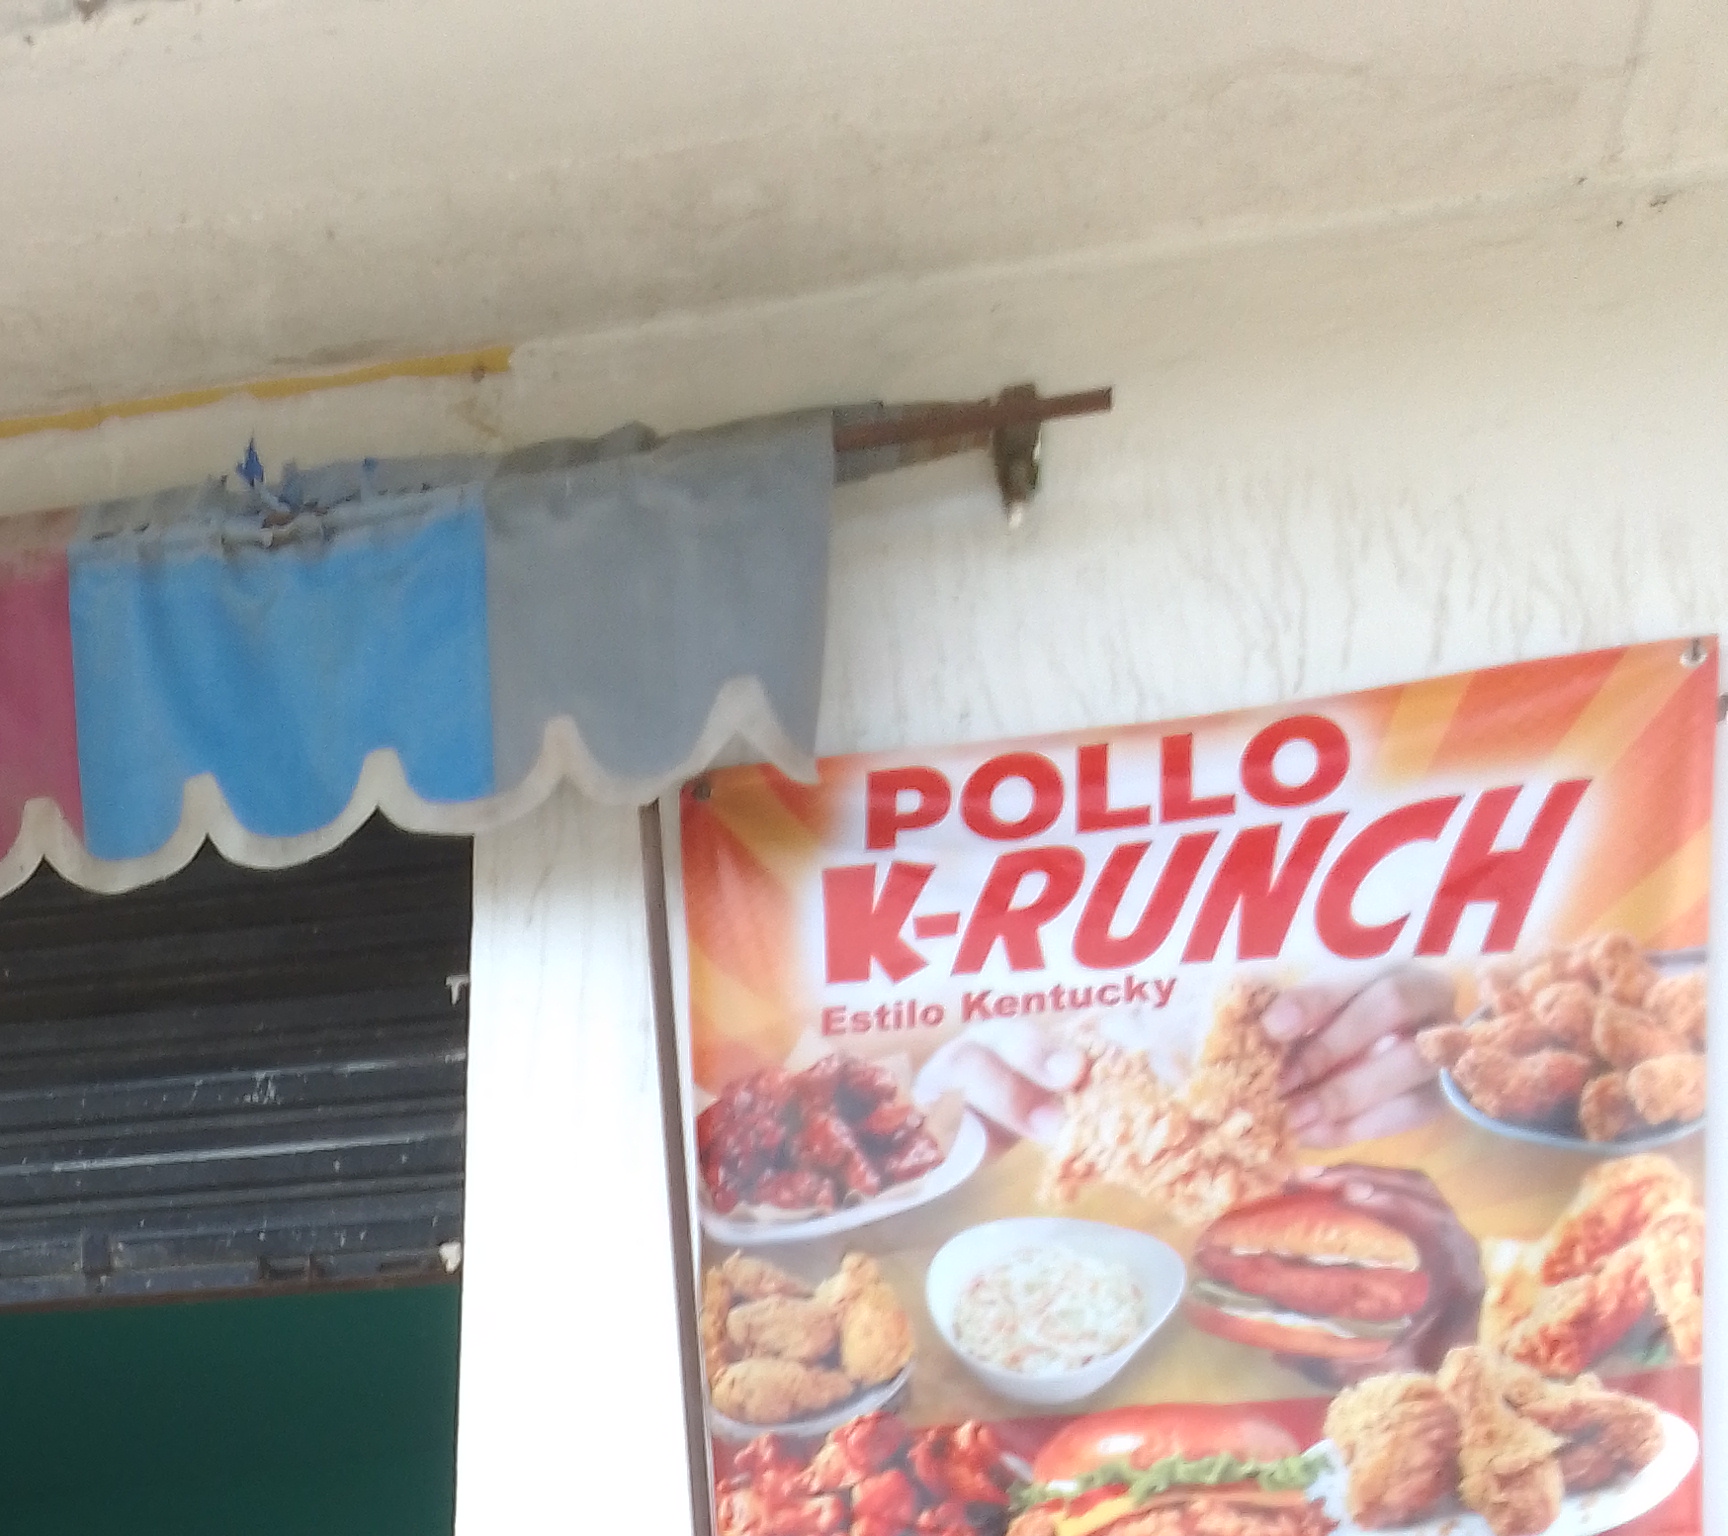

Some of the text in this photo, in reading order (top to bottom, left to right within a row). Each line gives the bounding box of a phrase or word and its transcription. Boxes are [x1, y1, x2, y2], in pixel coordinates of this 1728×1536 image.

[865, 714, 1351, 849] POLLO
[823, 778, 1591, 985] K-RUNCH
[820, 977, 1175, 1037] Estilo Kentucky
